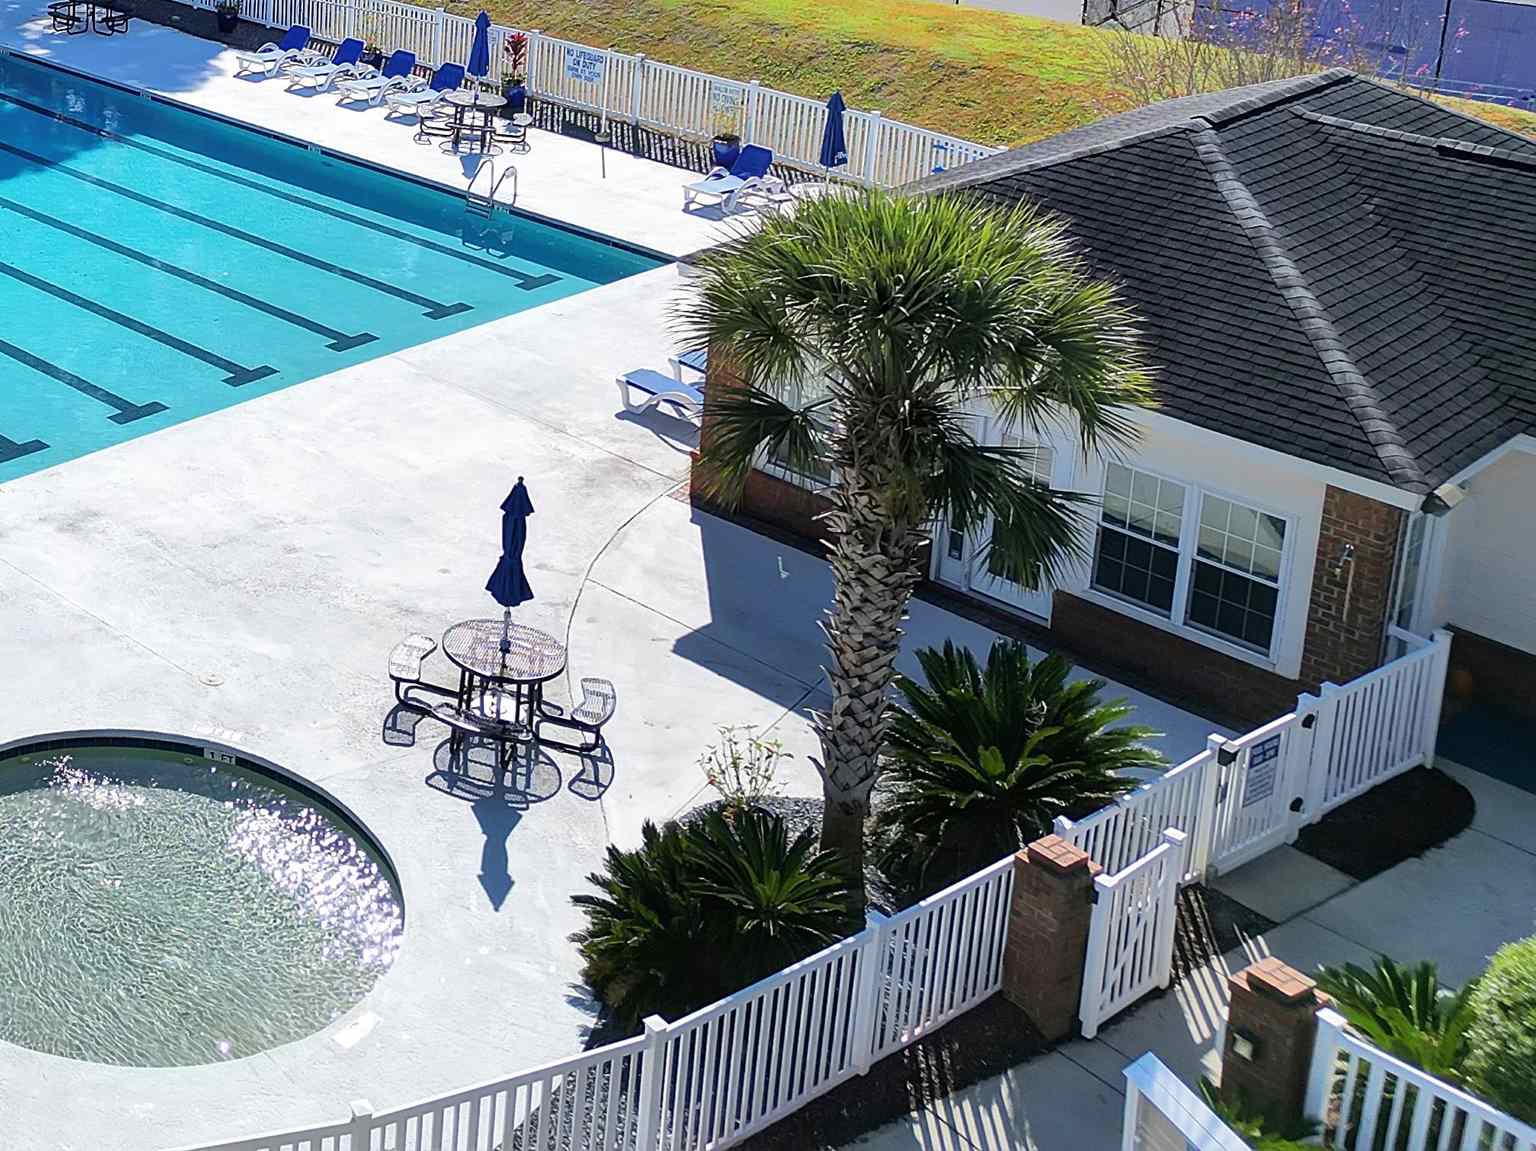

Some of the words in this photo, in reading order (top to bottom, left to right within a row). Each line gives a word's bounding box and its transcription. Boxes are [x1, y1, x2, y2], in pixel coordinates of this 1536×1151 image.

[567, 47, 574, 57] NO
[575, 49, 604, 64] LIFEGUARD
[573, 58, 581, 66] ON
[582, 60, 596, 70] DUTY
